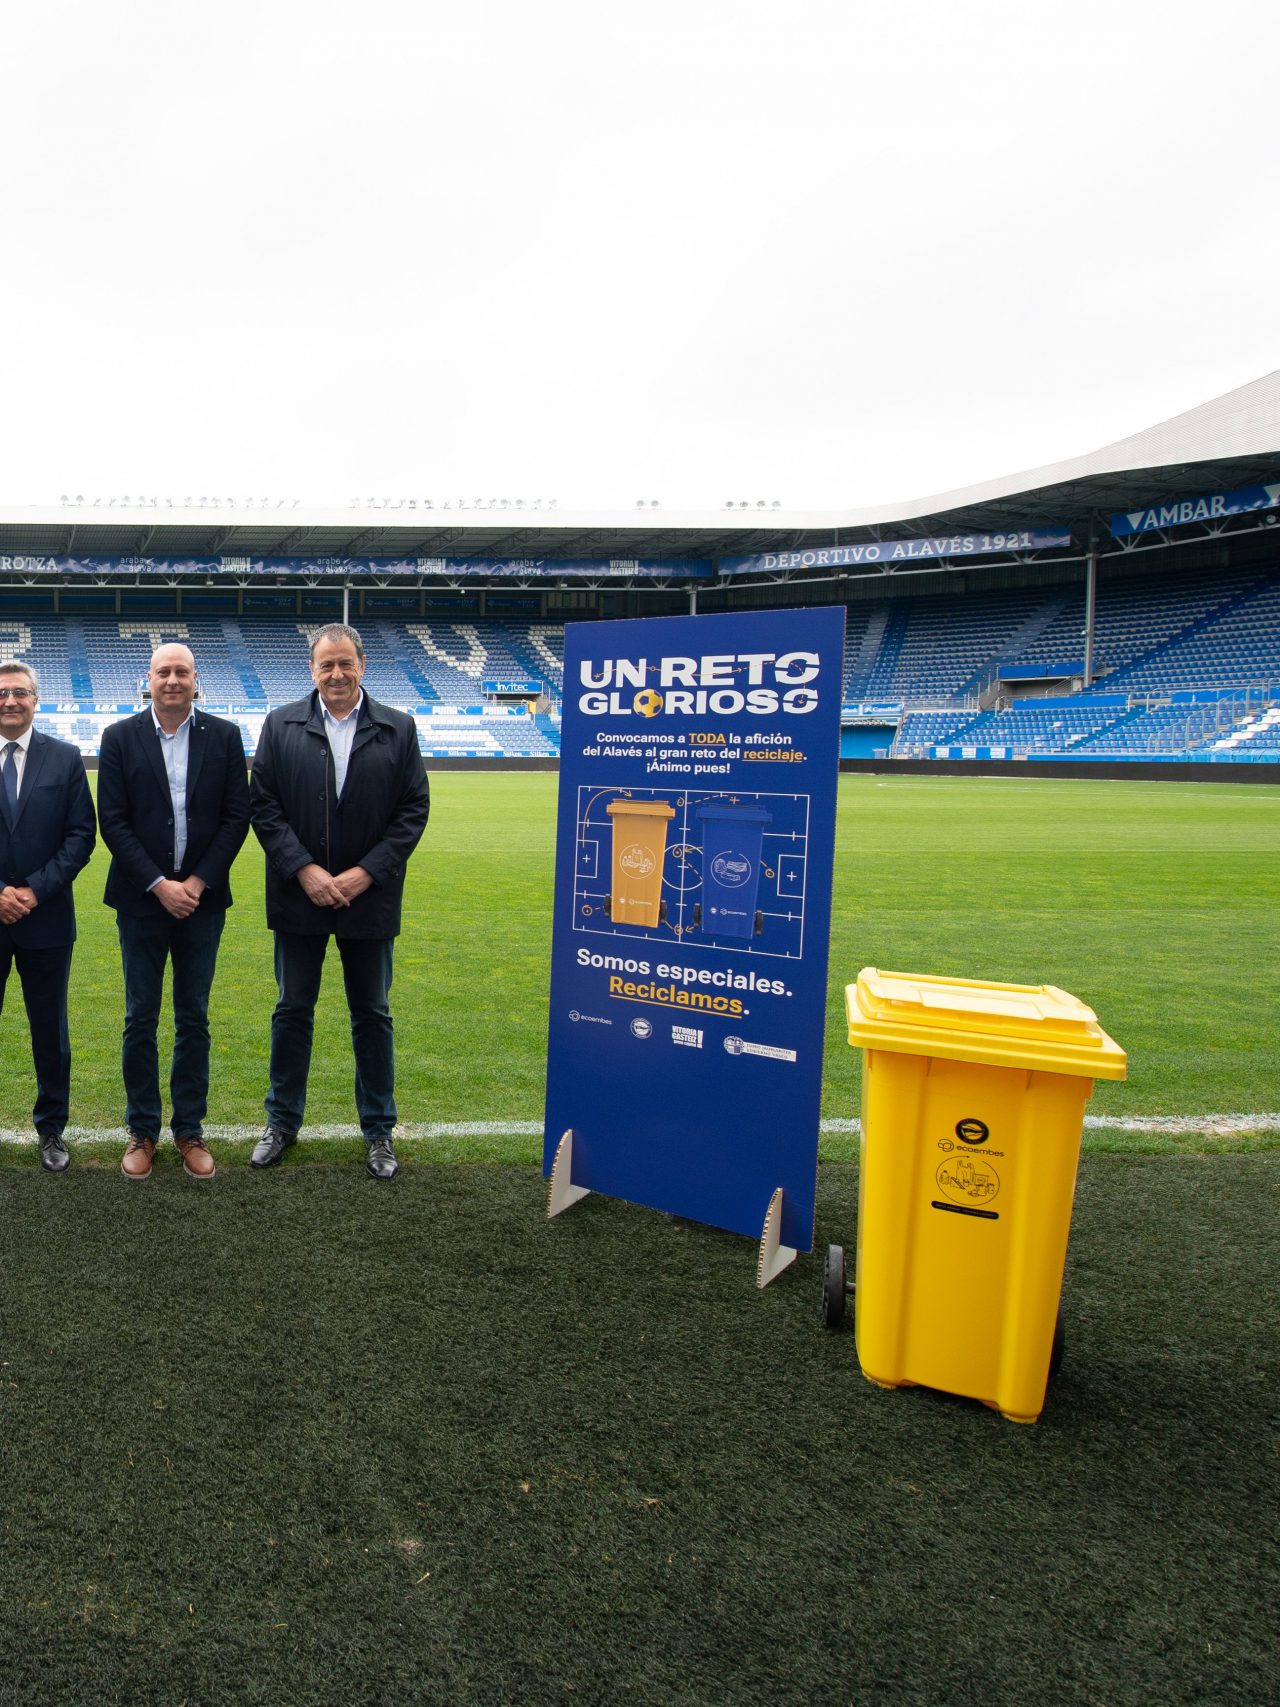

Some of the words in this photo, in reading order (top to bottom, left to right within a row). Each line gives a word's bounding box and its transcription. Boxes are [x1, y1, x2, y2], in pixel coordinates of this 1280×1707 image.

[1143, 495, 1227, 529] AMBAR
[764, 546, 880, 569] DEPORTIVO
[892, 535, 974, 559] ALAVÉS
[982, 532, 1032, 551] 1921
[580, 658, 646, 688] UN
[660, 652, 820, 687] RETO
[56, 704, 79, 712] LEA
[95, 704, 117, 712] LEA
[596, 732, 675, 743] Convocamos
[678, 735, 685, 743] a
[689, 733, 726, 744] TODA
[729, 733, 741, 744] la
[745, 732, 792, 745] afición
[583, 745, 600, 756] del
[603, 745, 642, 757] Alavés
[645, 747, 656, 757] al
[659, 749, 687, 760] gran
[690, 749, 716, 759] reto
[719, 748, 741, 759] del
[743, 748, 808, 761] reciclaje.
[646, 759, 691, 773] ¡Ánimo
[694, 762, 731, 775] pues!
[577, 948, 650, 975] Somos
[657, 962, 793, 997] especiales.
[609, 975, 750, 1015] Reciclamos.
[581, 1014, 612, 1025] ecoembes
[672, 1026, 697, 1036] VITORIA
[956, 1145, 1004, 1157] ecoembes
